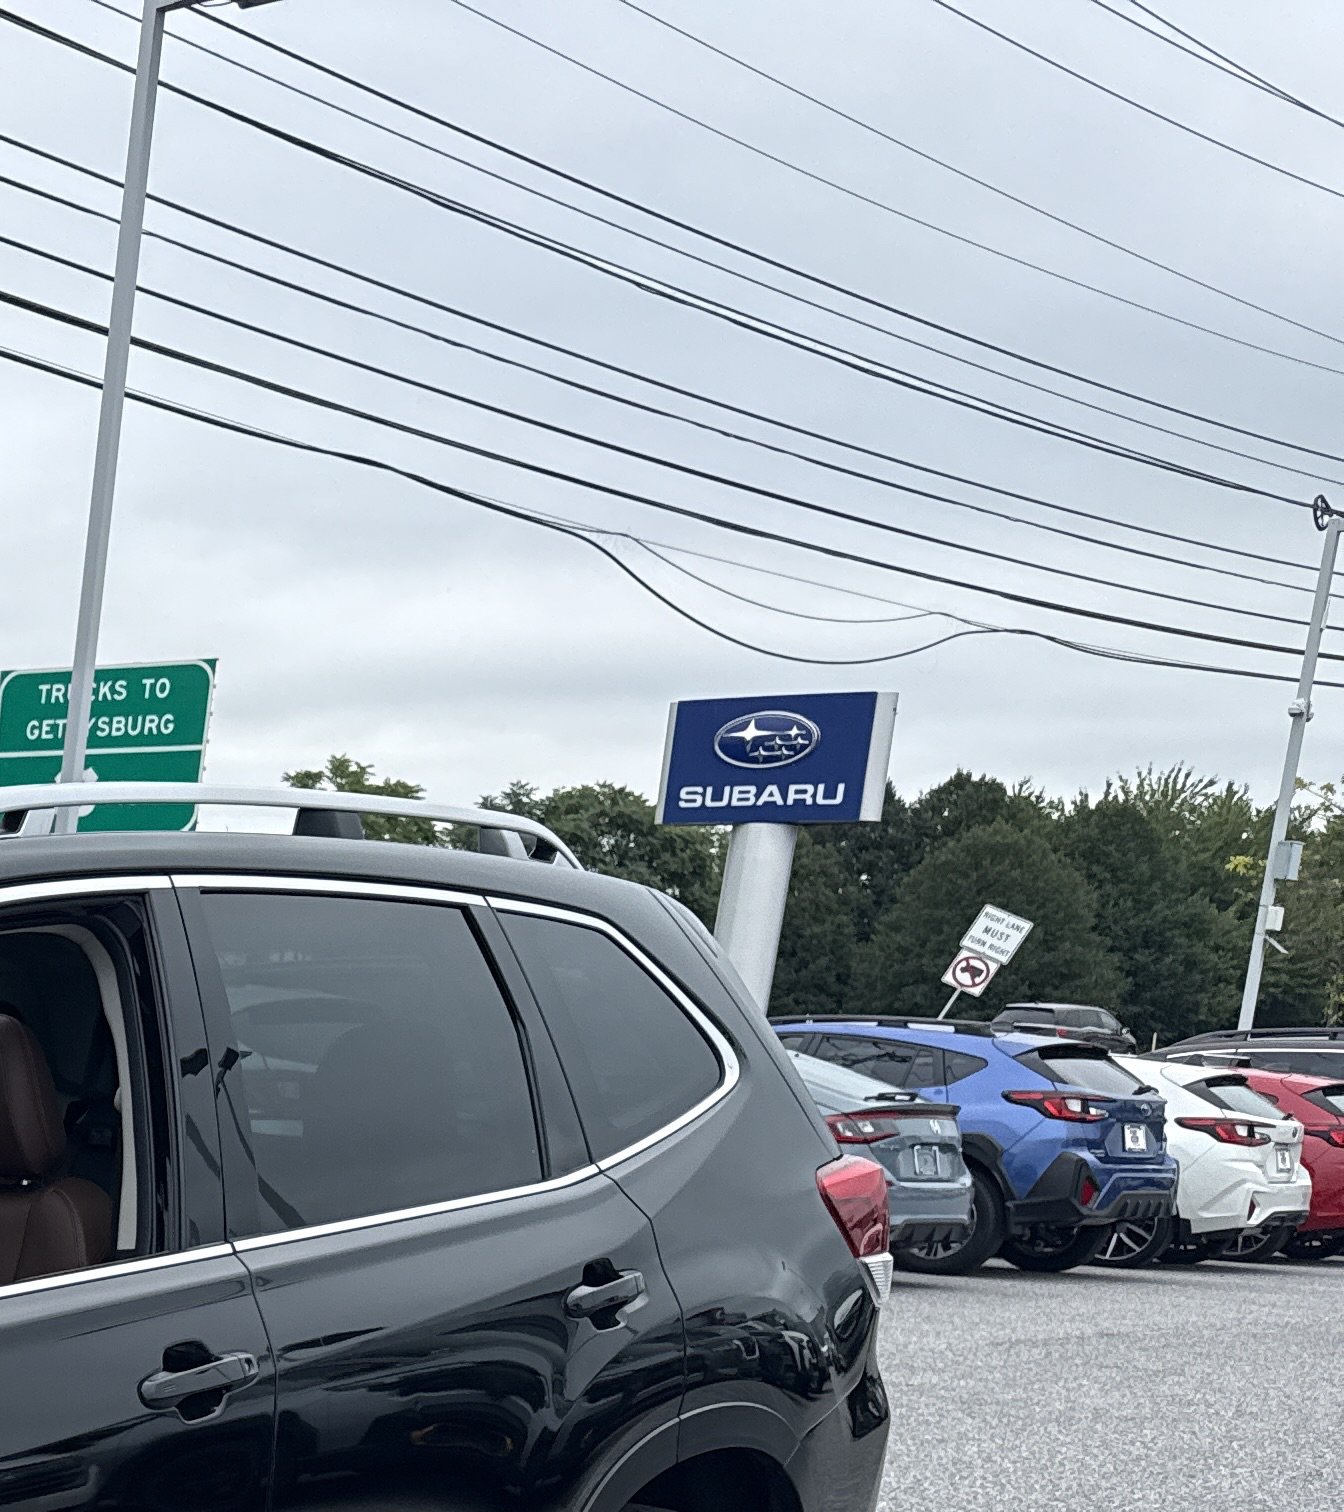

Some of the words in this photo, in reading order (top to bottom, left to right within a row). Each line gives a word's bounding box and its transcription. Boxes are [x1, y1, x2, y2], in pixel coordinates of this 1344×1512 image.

[38, 680, 127, 704] TRKS
[142, 678, 170, 700] TO
[26, 713, 175, 740] GETSBURG
[678, 783, 845, 808] SUBARU
[982, 925, 1011, 943] MUST
[983, 911, 1006, 925] RIGHT
[1005, 921, 1026, 934] LANE
[988, 943, 1010, 957] RIGHT
